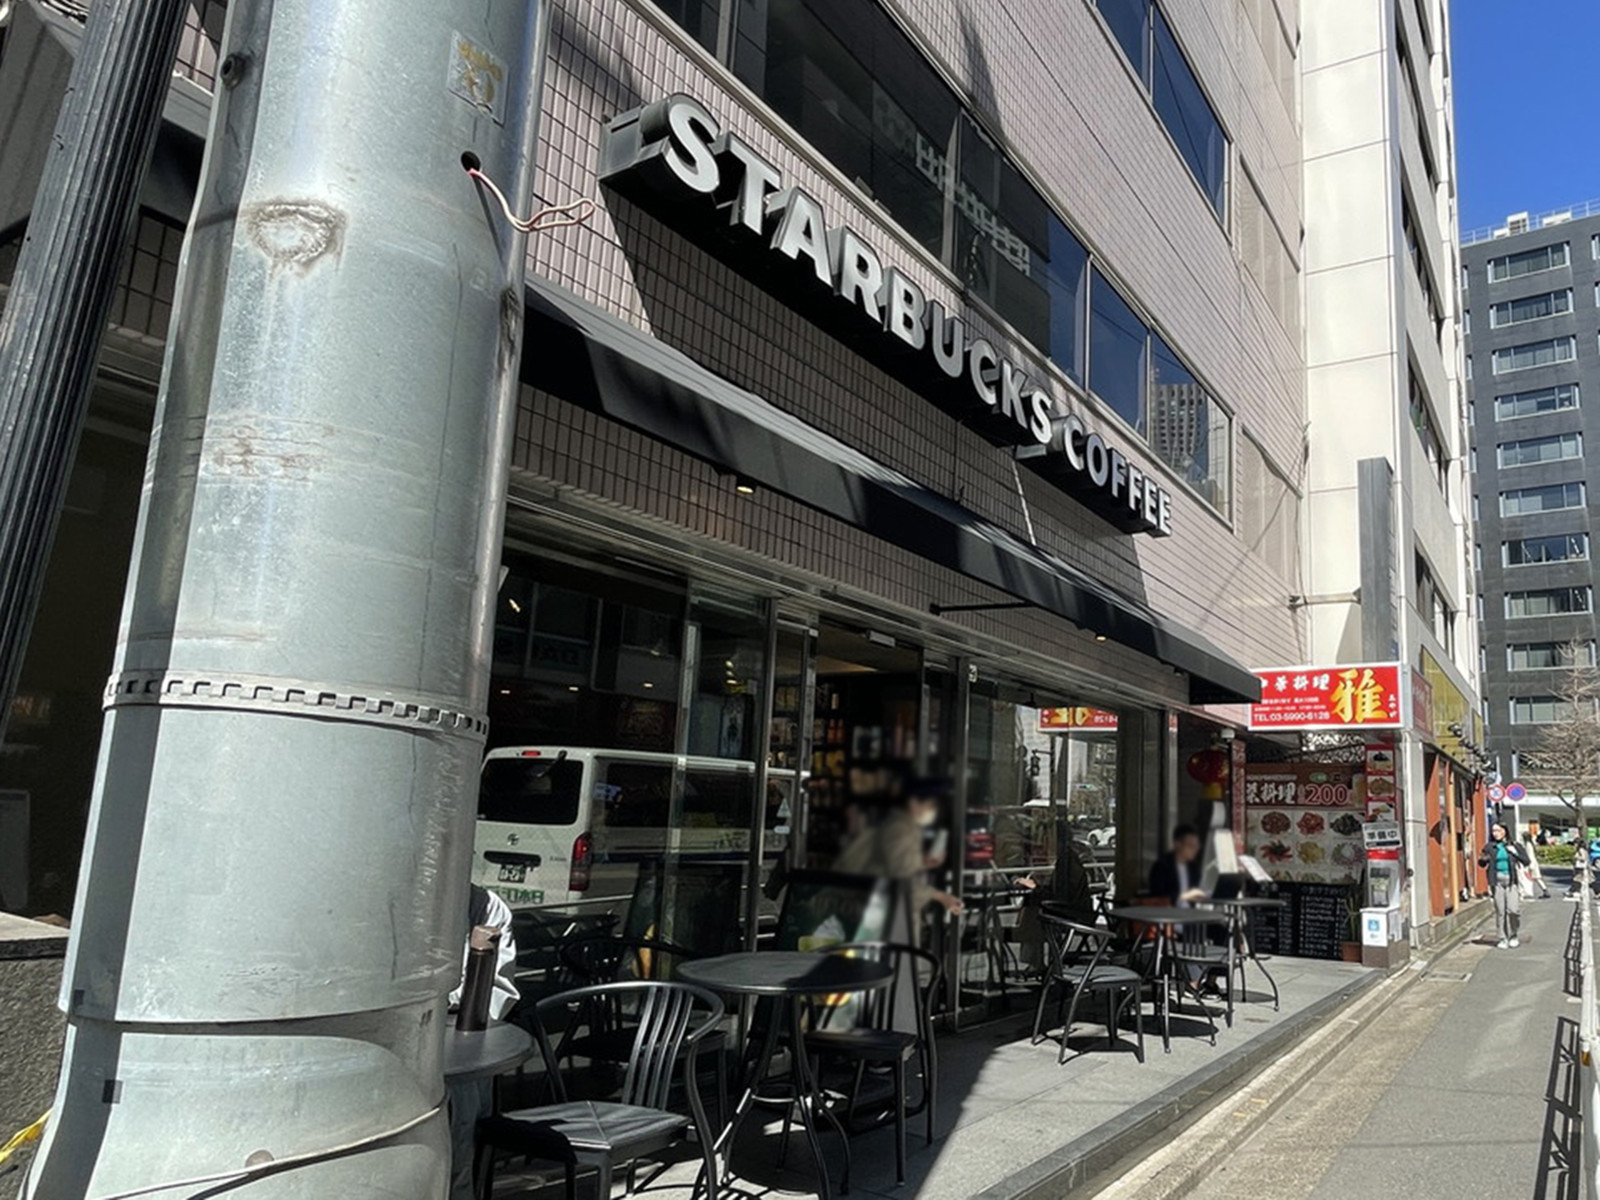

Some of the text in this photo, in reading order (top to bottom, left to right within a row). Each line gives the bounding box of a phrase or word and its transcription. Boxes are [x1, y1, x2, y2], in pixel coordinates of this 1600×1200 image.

[664, 94, 1053, 444] STARBUCKS
[1063, 414, 1172, 536] COFFEE
[1331, 668, 1389, 723] 雅
[1305, 783, 1349, 805] 200
